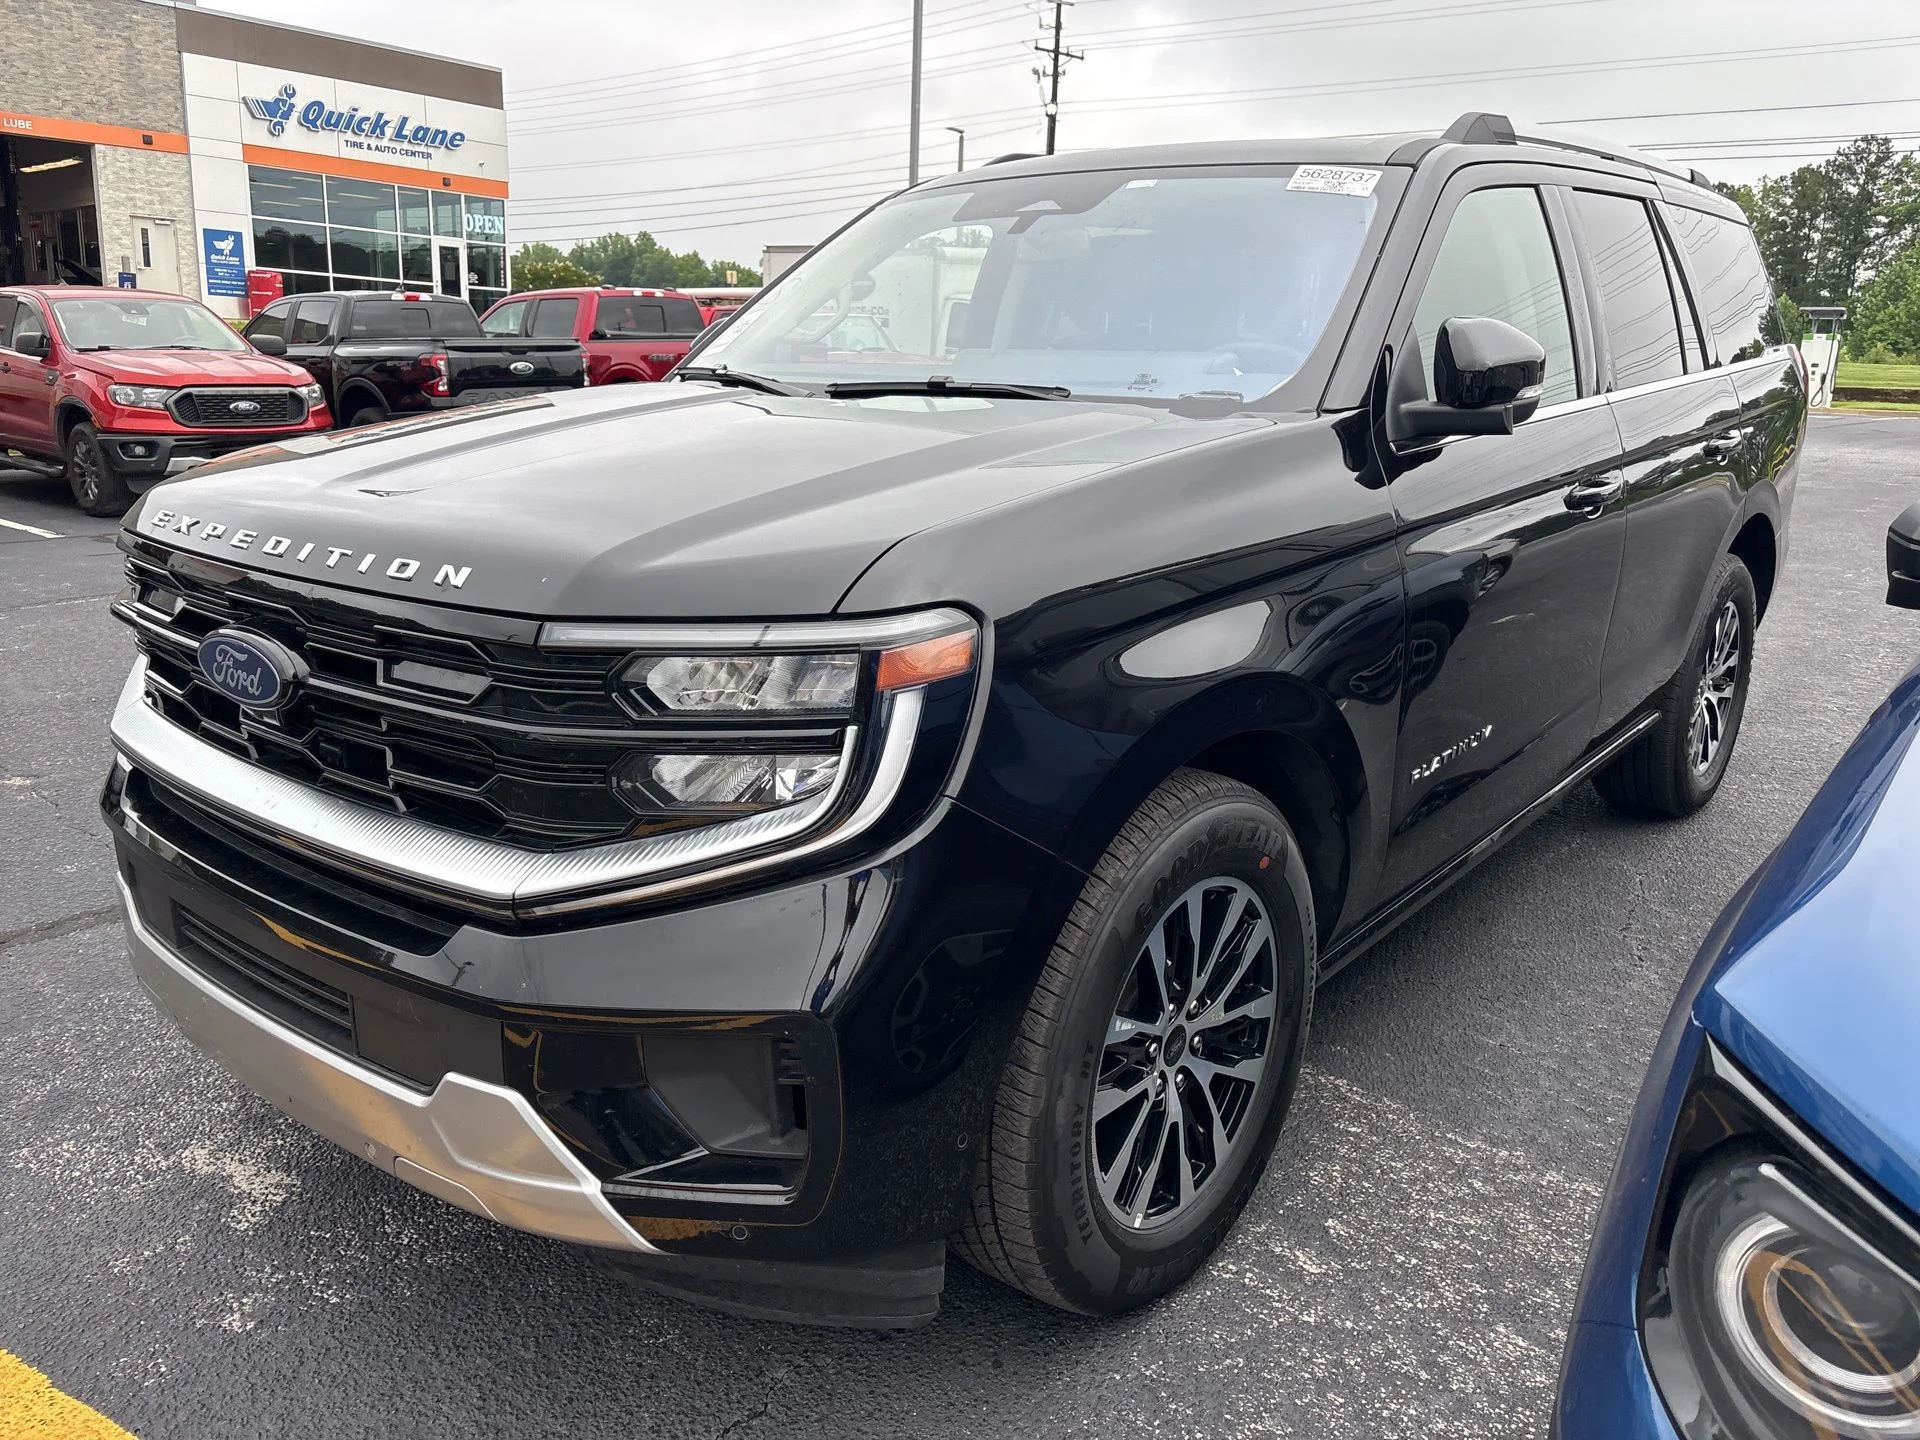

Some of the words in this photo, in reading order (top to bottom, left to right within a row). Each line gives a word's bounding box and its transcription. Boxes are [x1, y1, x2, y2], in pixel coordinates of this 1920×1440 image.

[3, 117, 33, 130] LUBE
[300, 100, 392, 137] Quick
[393, 114, 466, 149] Lane
[344, 140, 365, 150] TIRE
[367, 143, 373, 151] &
[374, 144, 398, 154] AUTO
[399, 147, 433, 160] CENTER
[1299, 168, 1377, 183] 5628737
[464, 213, 505, 235] OPEN
[149, 508, 473, 589] EXPEDITION
[212, 644, 263, 697] Ford
[1409, 724, 1493, 785] PLATINUM
[1069, 1103, 1094, 1246] TERRITORY
